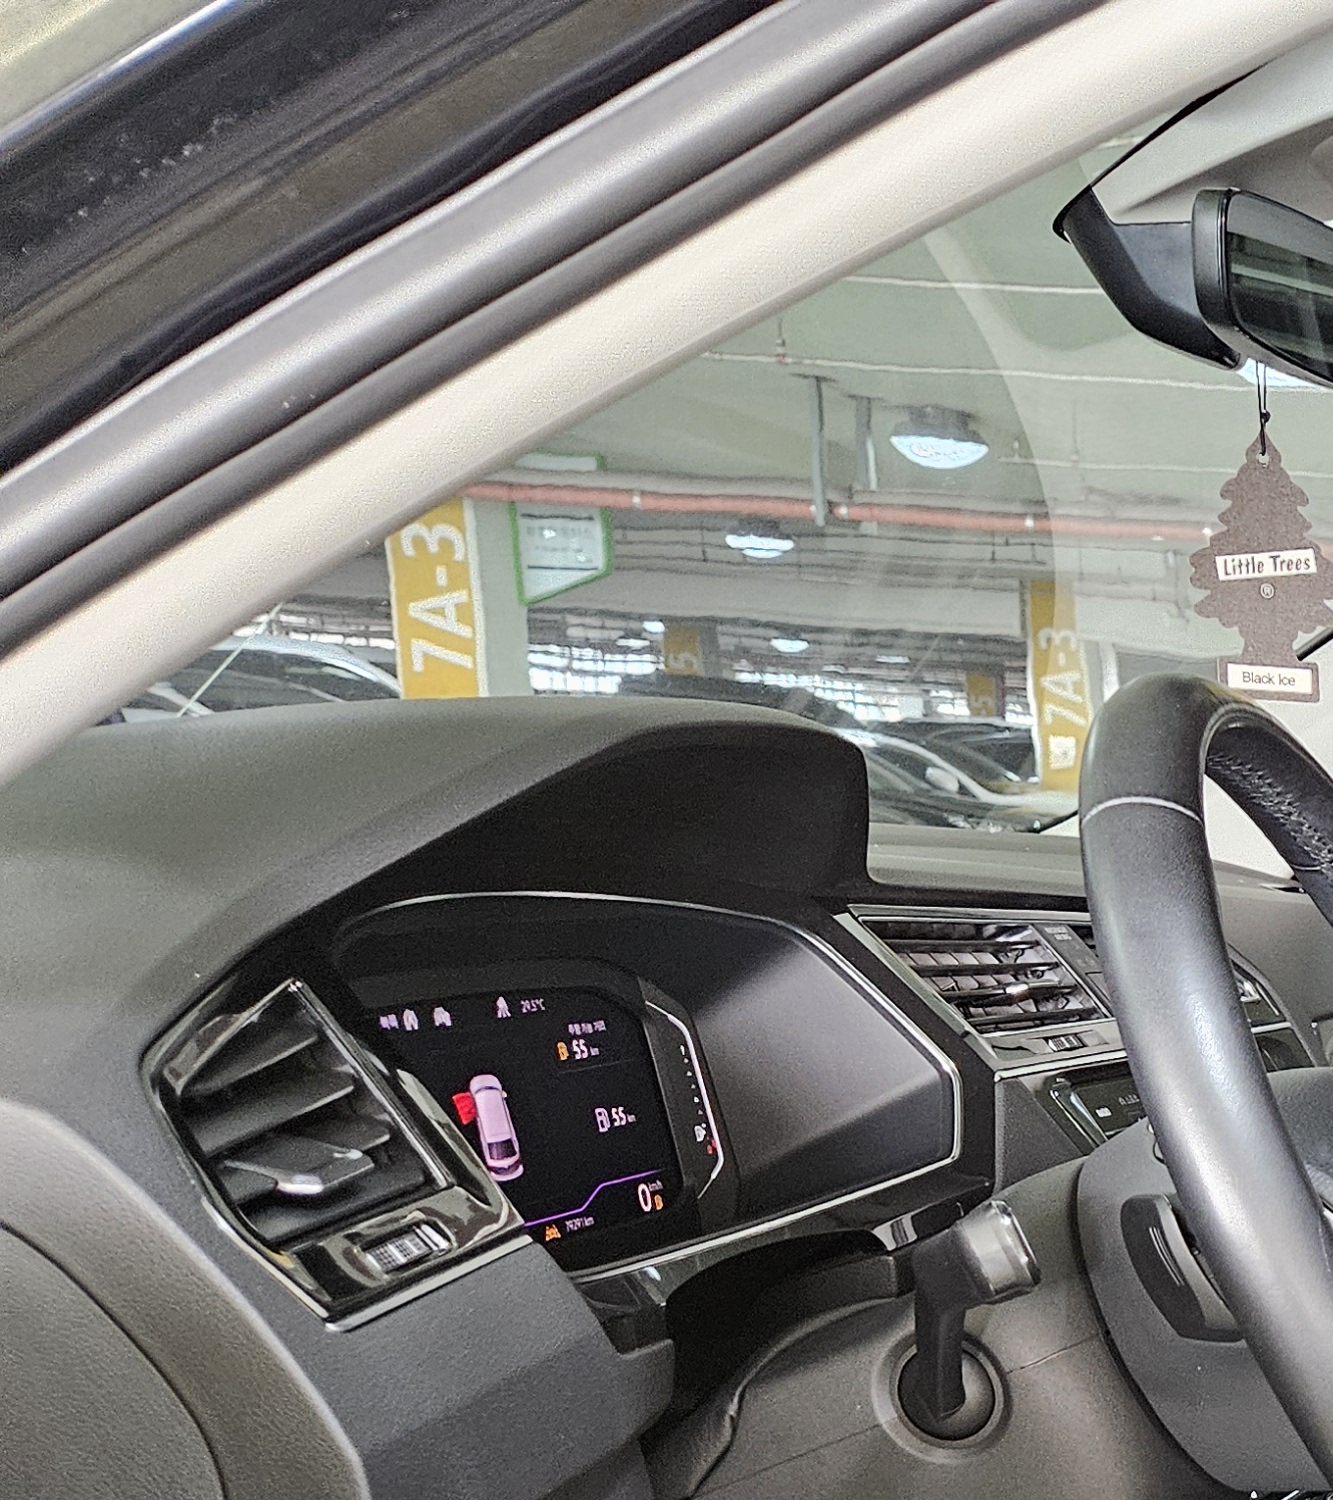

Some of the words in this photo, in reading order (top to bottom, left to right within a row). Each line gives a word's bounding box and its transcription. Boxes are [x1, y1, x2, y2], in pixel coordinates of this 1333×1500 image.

[1223, 556, 1265, 576] Little
[1269, 554, 1311, 573] Trees
[401, 523, 475, 674] 7A-3
[1040, 626, 1089, 728] 7A-3
[1242, 671, 1276, 685] Black
[1278, 673, 1296, 687] Ice
[572, 1039, 588, 1060] 55
[611, 1106, 627, 1127] 55
[637, 1183, 652, 1212] 0
